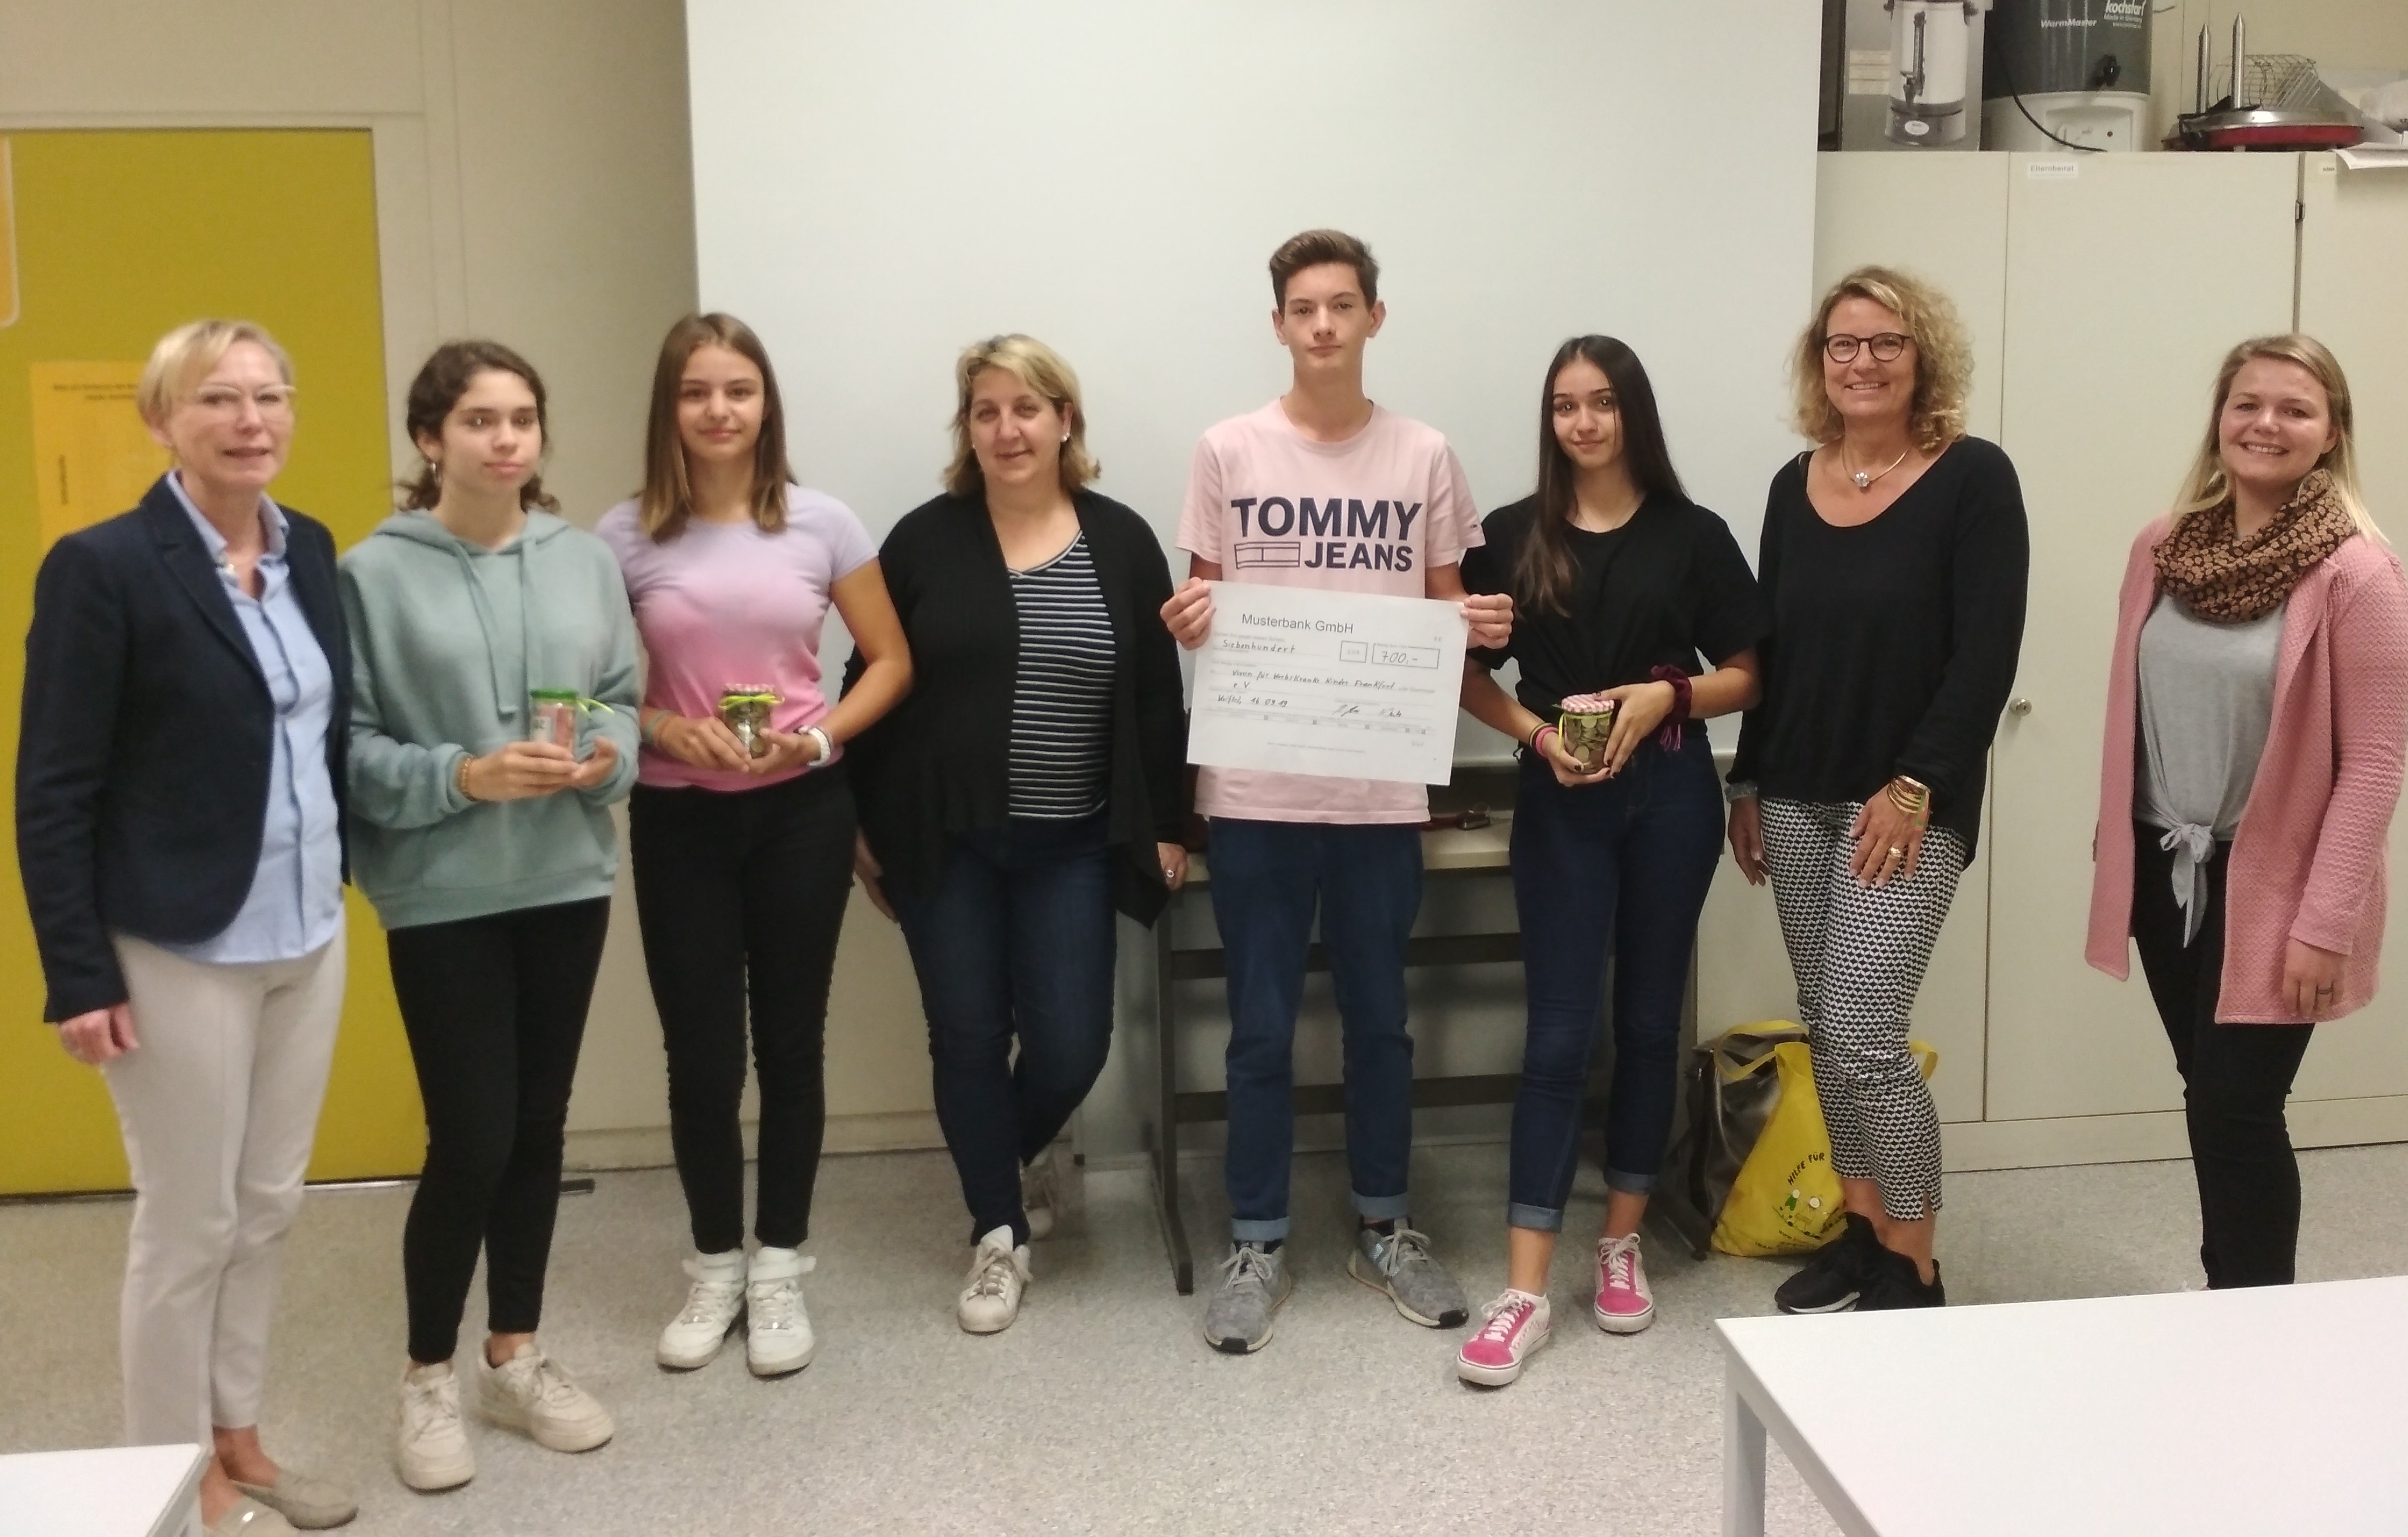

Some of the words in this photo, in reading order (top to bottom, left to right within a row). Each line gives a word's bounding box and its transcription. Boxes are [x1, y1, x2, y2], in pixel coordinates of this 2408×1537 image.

[2040, 19, 2097, 28] WarmMaster
[1230, 496, 1423, 541] TOMMY
[1304, 542, 1413, 572] JEANS
[1242, 613, 1311, 630] Musterbank
[1315, 620, 1354, 634] GmbH
[1788, 1160, 1806, 1185] HILFE
